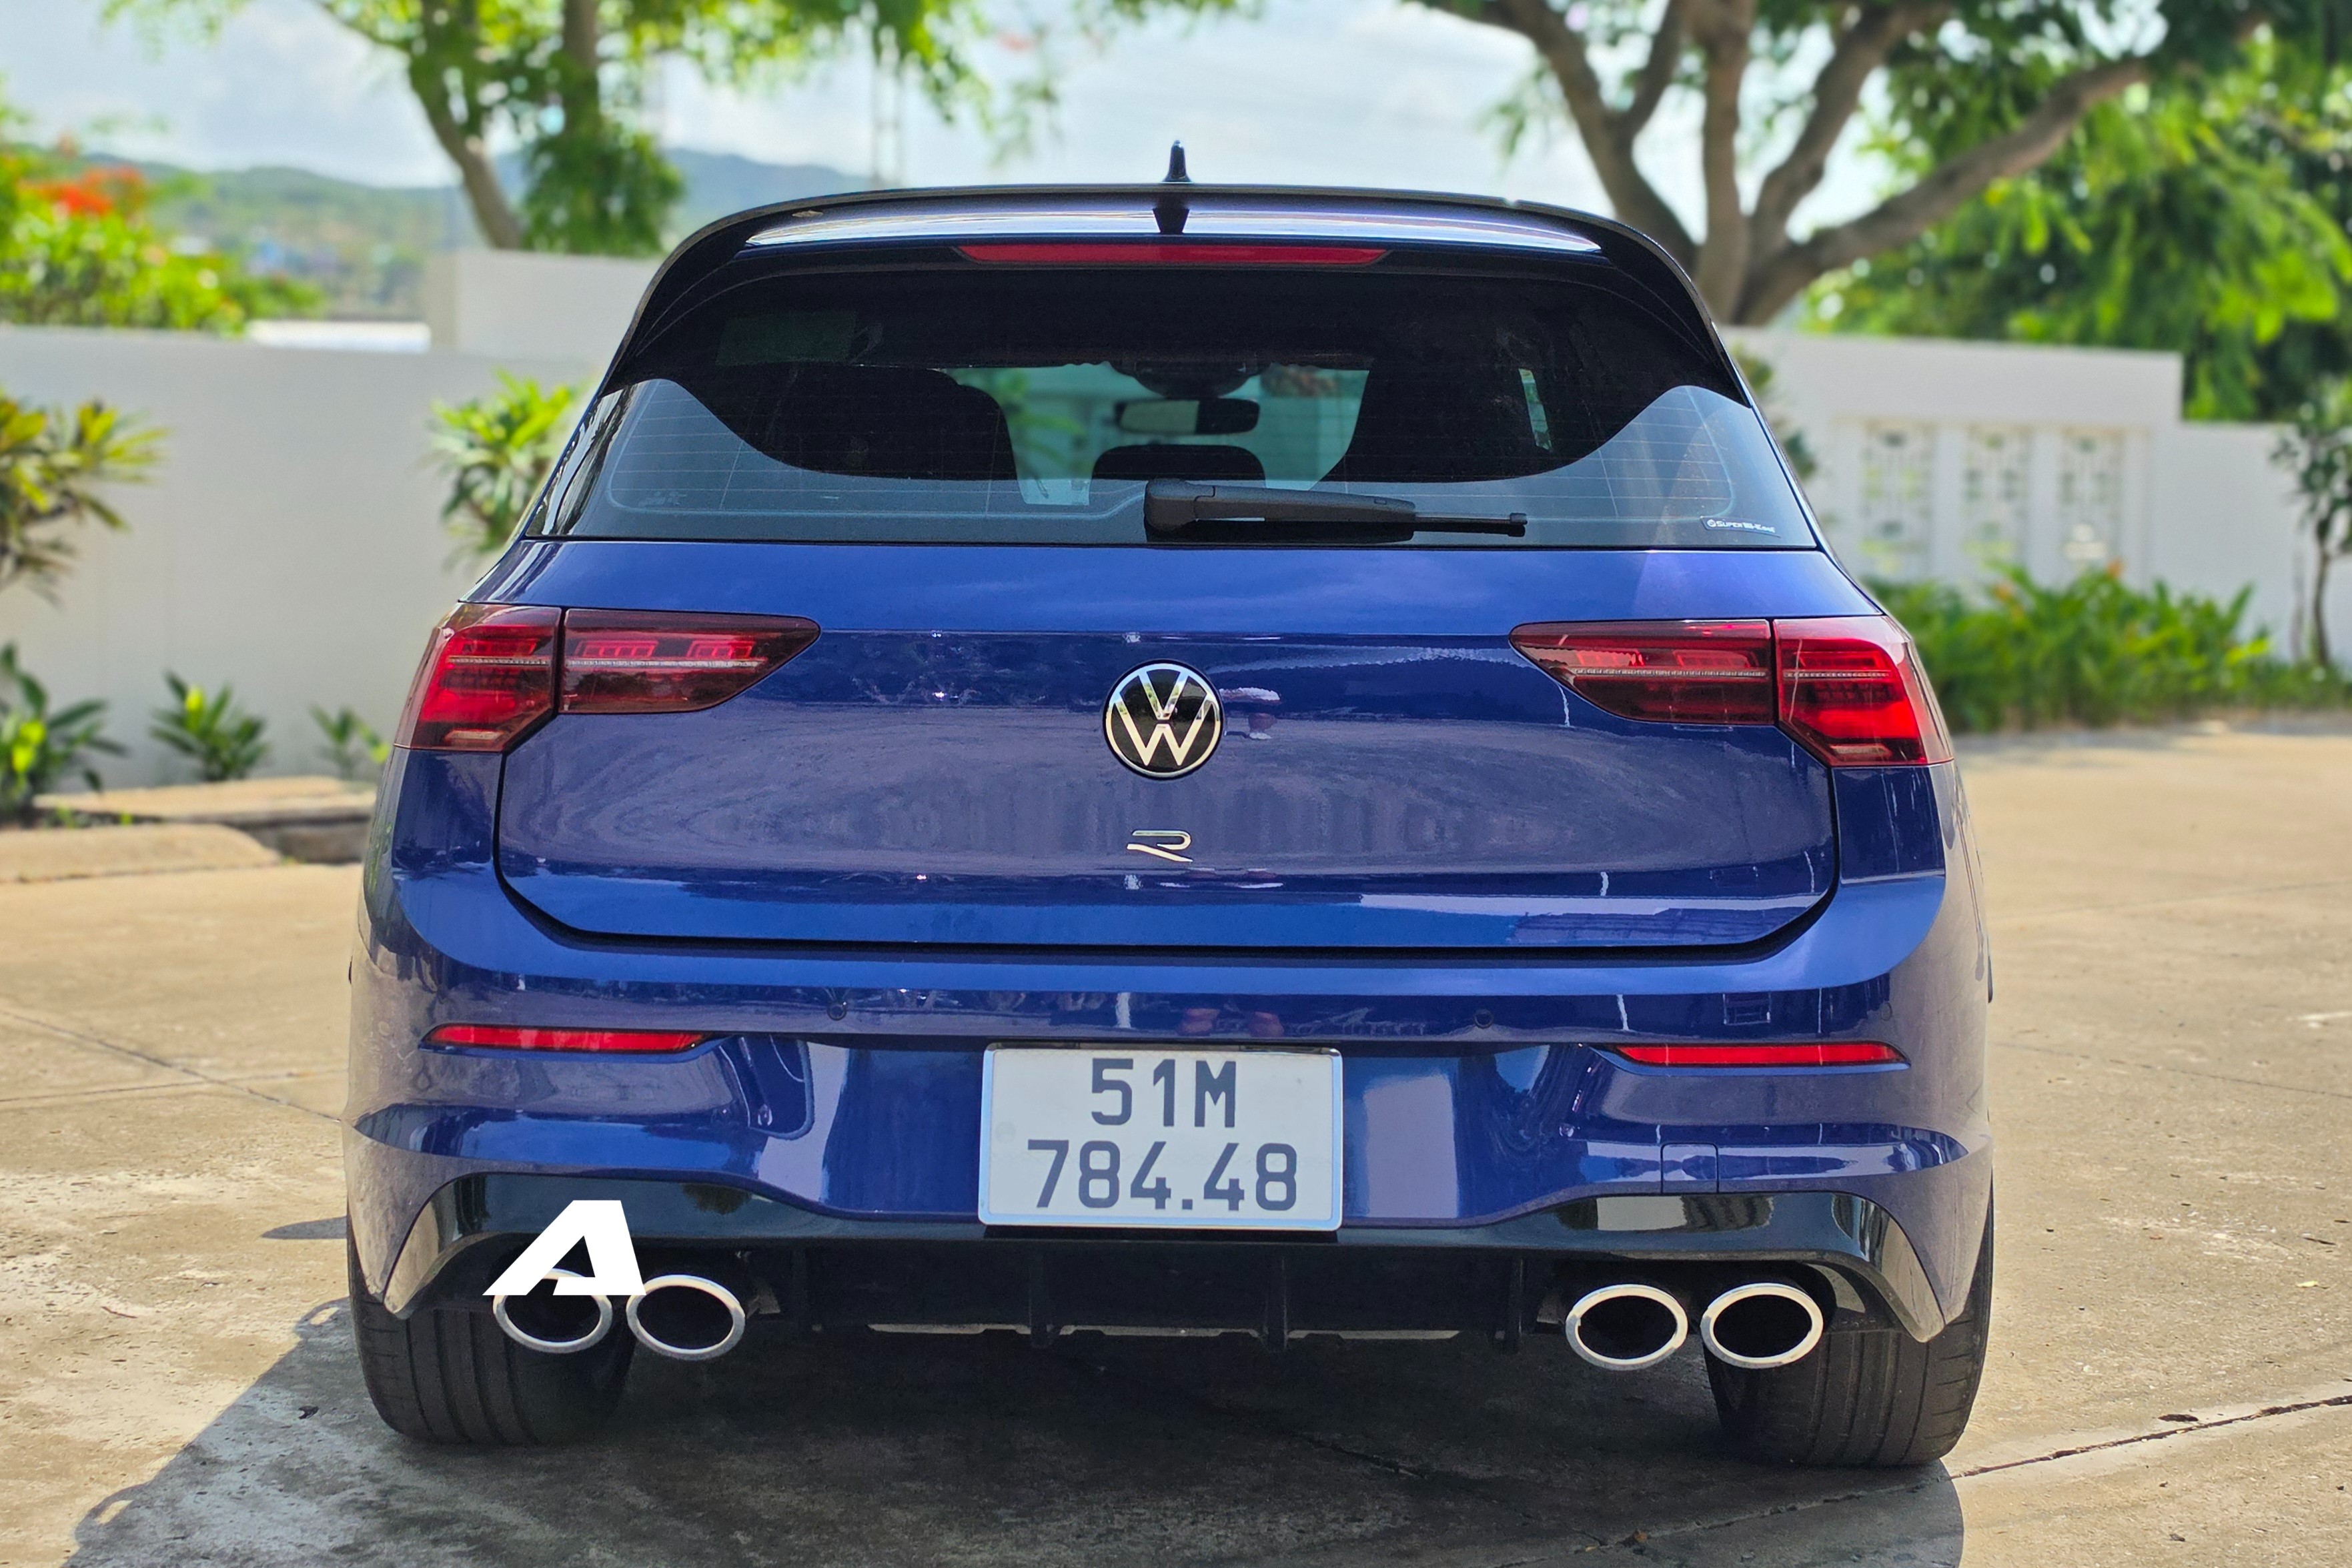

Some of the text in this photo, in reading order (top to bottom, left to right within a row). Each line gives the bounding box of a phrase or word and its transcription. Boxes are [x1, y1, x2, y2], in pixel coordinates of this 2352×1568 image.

[1110, 666, 1215, 767] VW
[1127, 830, 1193, 862] R
[1091, 1057, 1237, 1128] 51M
[1027, 1138, 1297, 1211] 784.48
